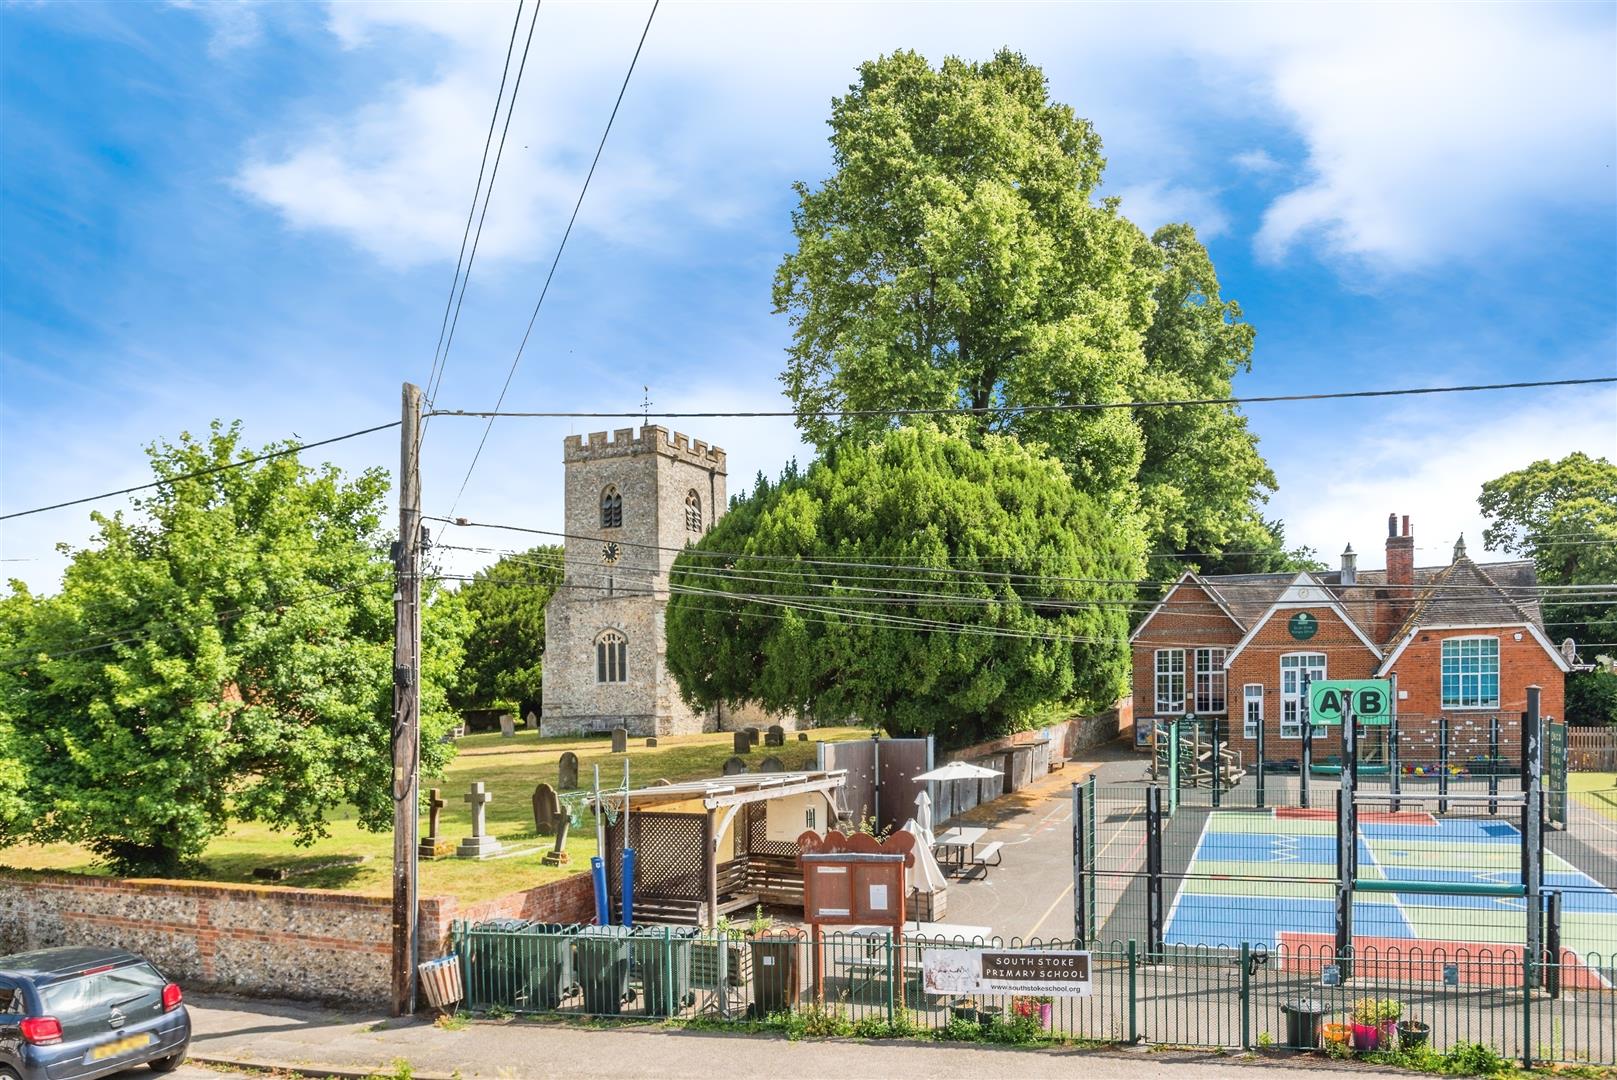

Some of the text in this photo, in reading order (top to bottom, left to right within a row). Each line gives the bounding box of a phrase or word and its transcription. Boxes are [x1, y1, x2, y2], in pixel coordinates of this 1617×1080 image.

[1320, 691, 1382, 714] A B
[996, 957, 1075, 967] SOUTH STOKE
[986, 968, 1085, 979] PRIMARY SCHOOL
[990, 984, 1081, 993] www.southstokeschool.org
